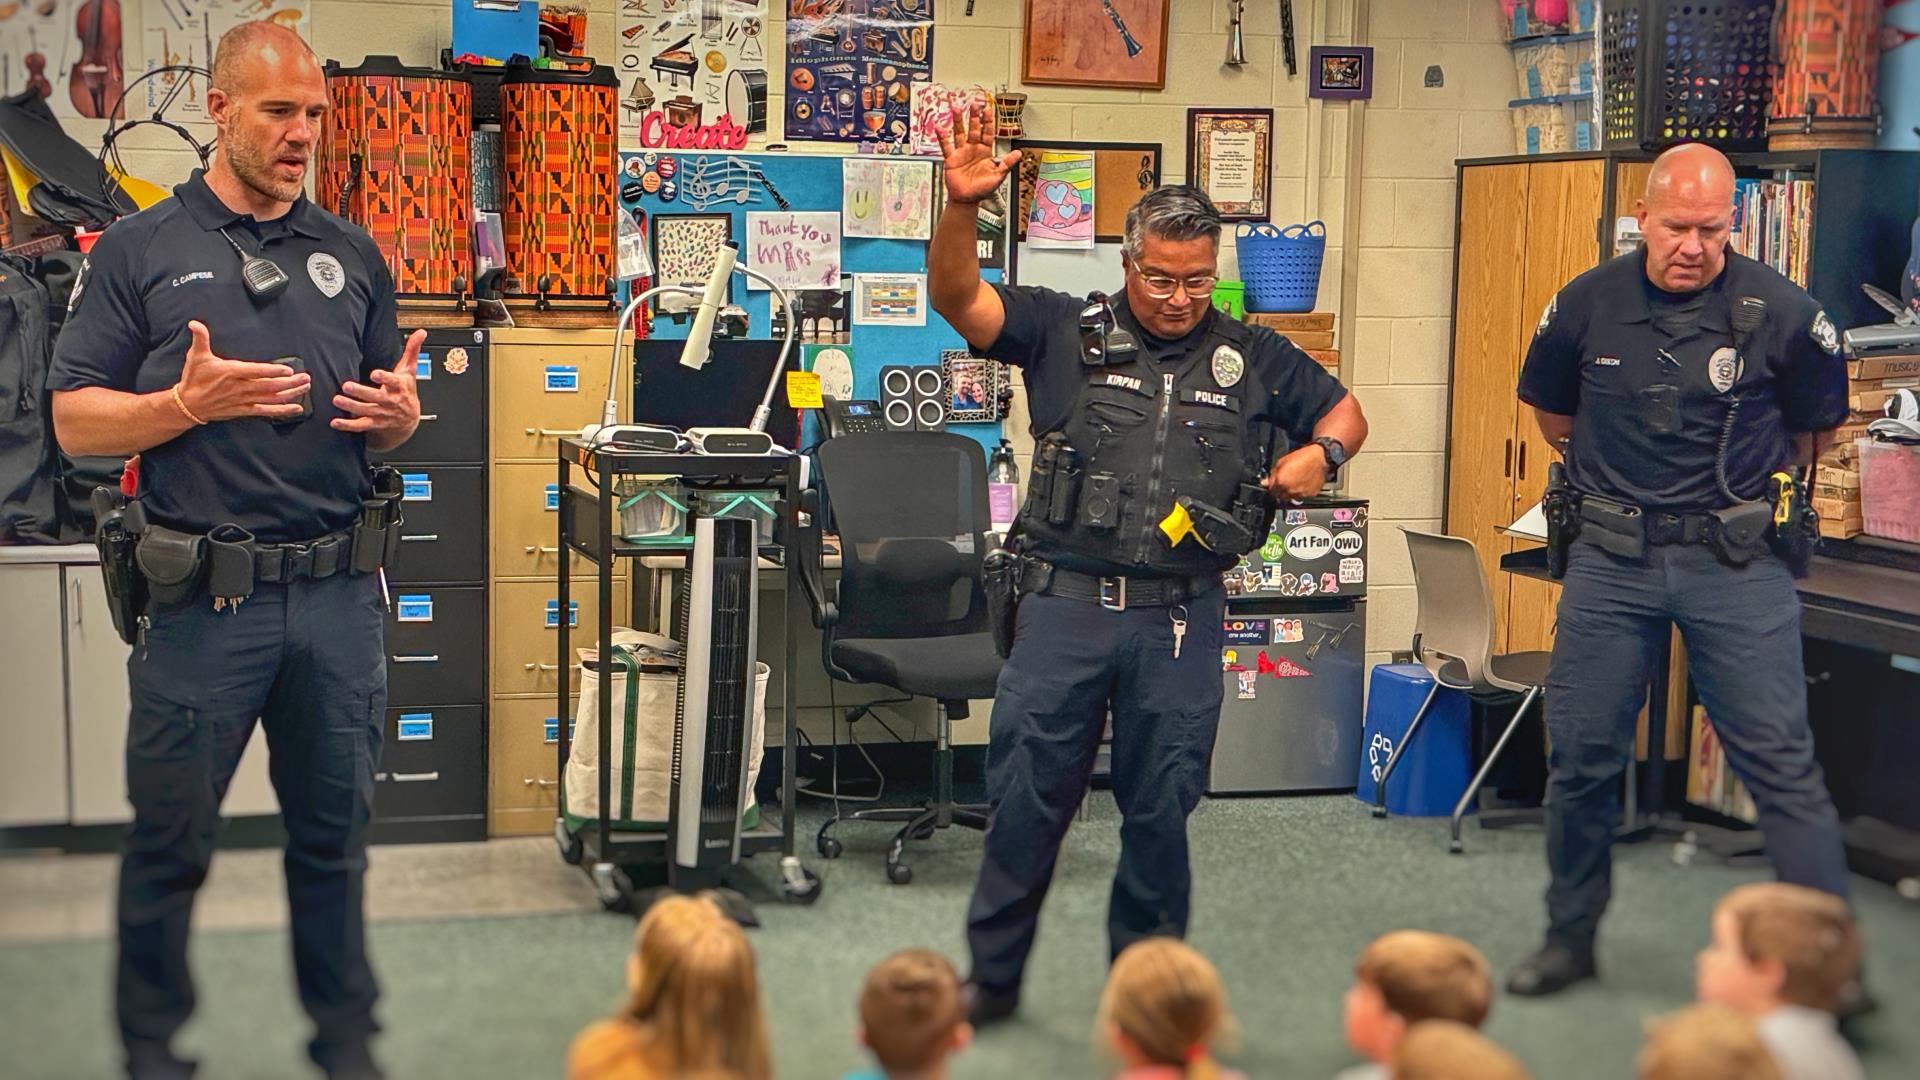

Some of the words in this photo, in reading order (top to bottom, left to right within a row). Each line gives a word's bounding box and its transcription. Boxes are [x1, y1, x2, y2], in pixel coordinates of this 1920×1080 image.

[790, 56, 857, 64] Idiophones
[640, 110, 748, 150] Create
[758, 217, 801, 237] Thank
[801, 224, 832, 245] you
[1106, 373, 1141, 390] KIRPAN
[1195, 390, 1227, 406] POLICE
[1289, 536, 1307, 548] Art
[1310, 536, 1330, 548] Fan
[1334, 537, 1360, 549] OWU
[1262, 543, 1283, 557] Hello
[1223, 621, 1265, 631] LOVE
